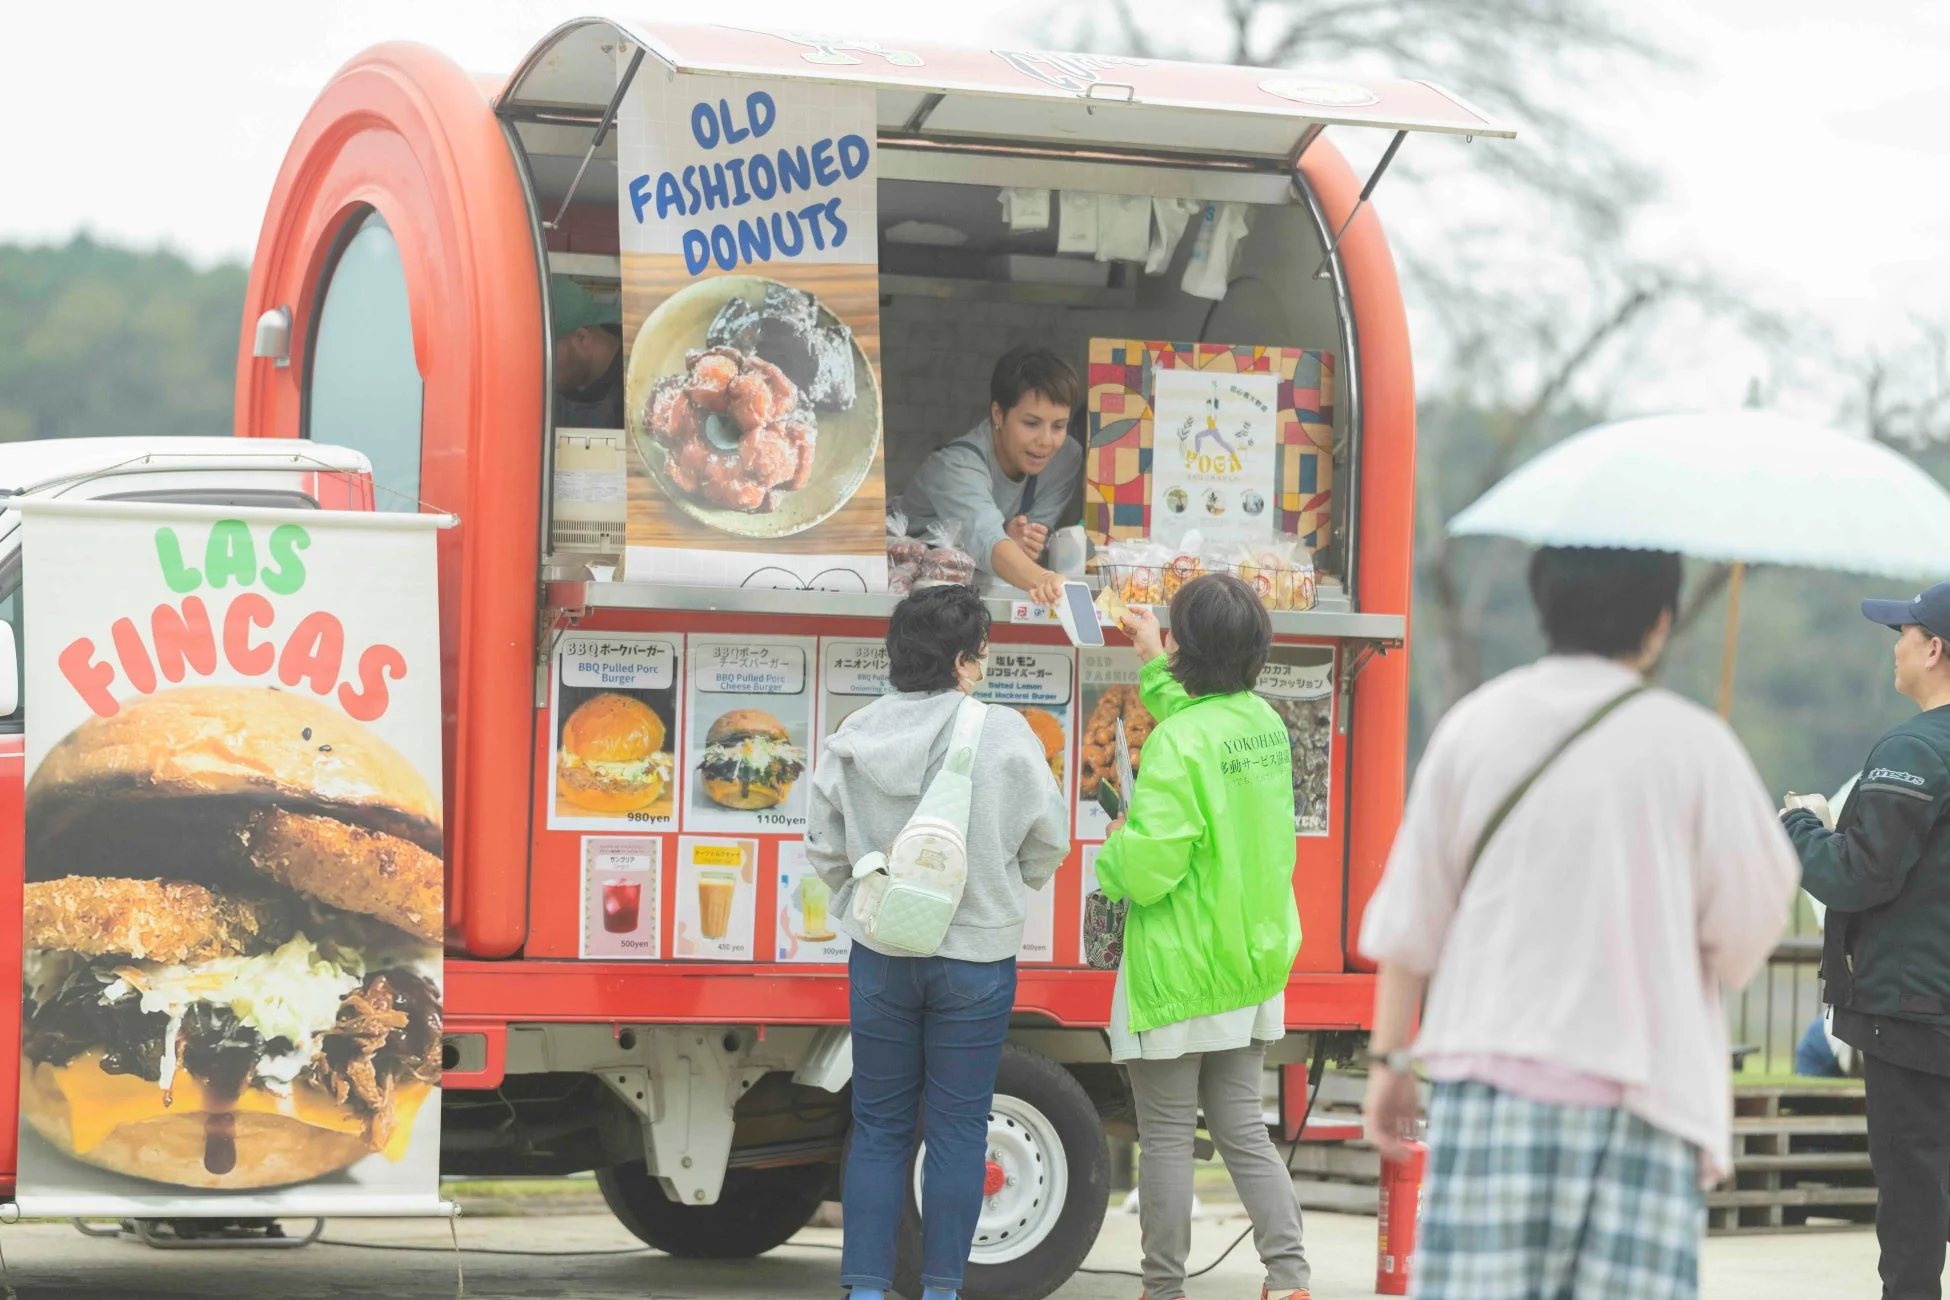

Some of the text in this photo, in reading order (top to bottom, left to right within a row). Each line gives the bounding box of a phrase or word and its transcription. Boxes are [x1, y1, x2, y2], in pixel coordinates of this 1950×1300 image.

[691, 91, 776, 150] OLD
[629, 134, 869, 224] FASHIONED
[682, 197, 848, 276] DONUTS
[154, 518, 312, 596] LAS
[58, 592, 408, 722] FINCAS
[719, 657, 790, 669] チーズバーガー
[1085, 656, 1113, 668] OLD
[578, 661, 660, 674] BBQ Pulled Porc
[1262, 665, 1291, 676] カカオ
[601, 673, 636, 686] Burger
[715, 672, 786, 684] BBQ Pulled Porc
[1256, 677, 1323, 689] ドファッション
[720, 682, 783, 693] Cheese Burger
[988, 681, 1042, 691] Salted Lemon
[1031, 692, 1057, 701] Burger
[1223, 730, 1288, 754] YOKOHAMA
[627, 812, 670, 824] 980yen
[756, 814, 806, 826] 1100yen
[620, 940, 649, 948] 500yen
[823, 948, 848, 956] 300yen
